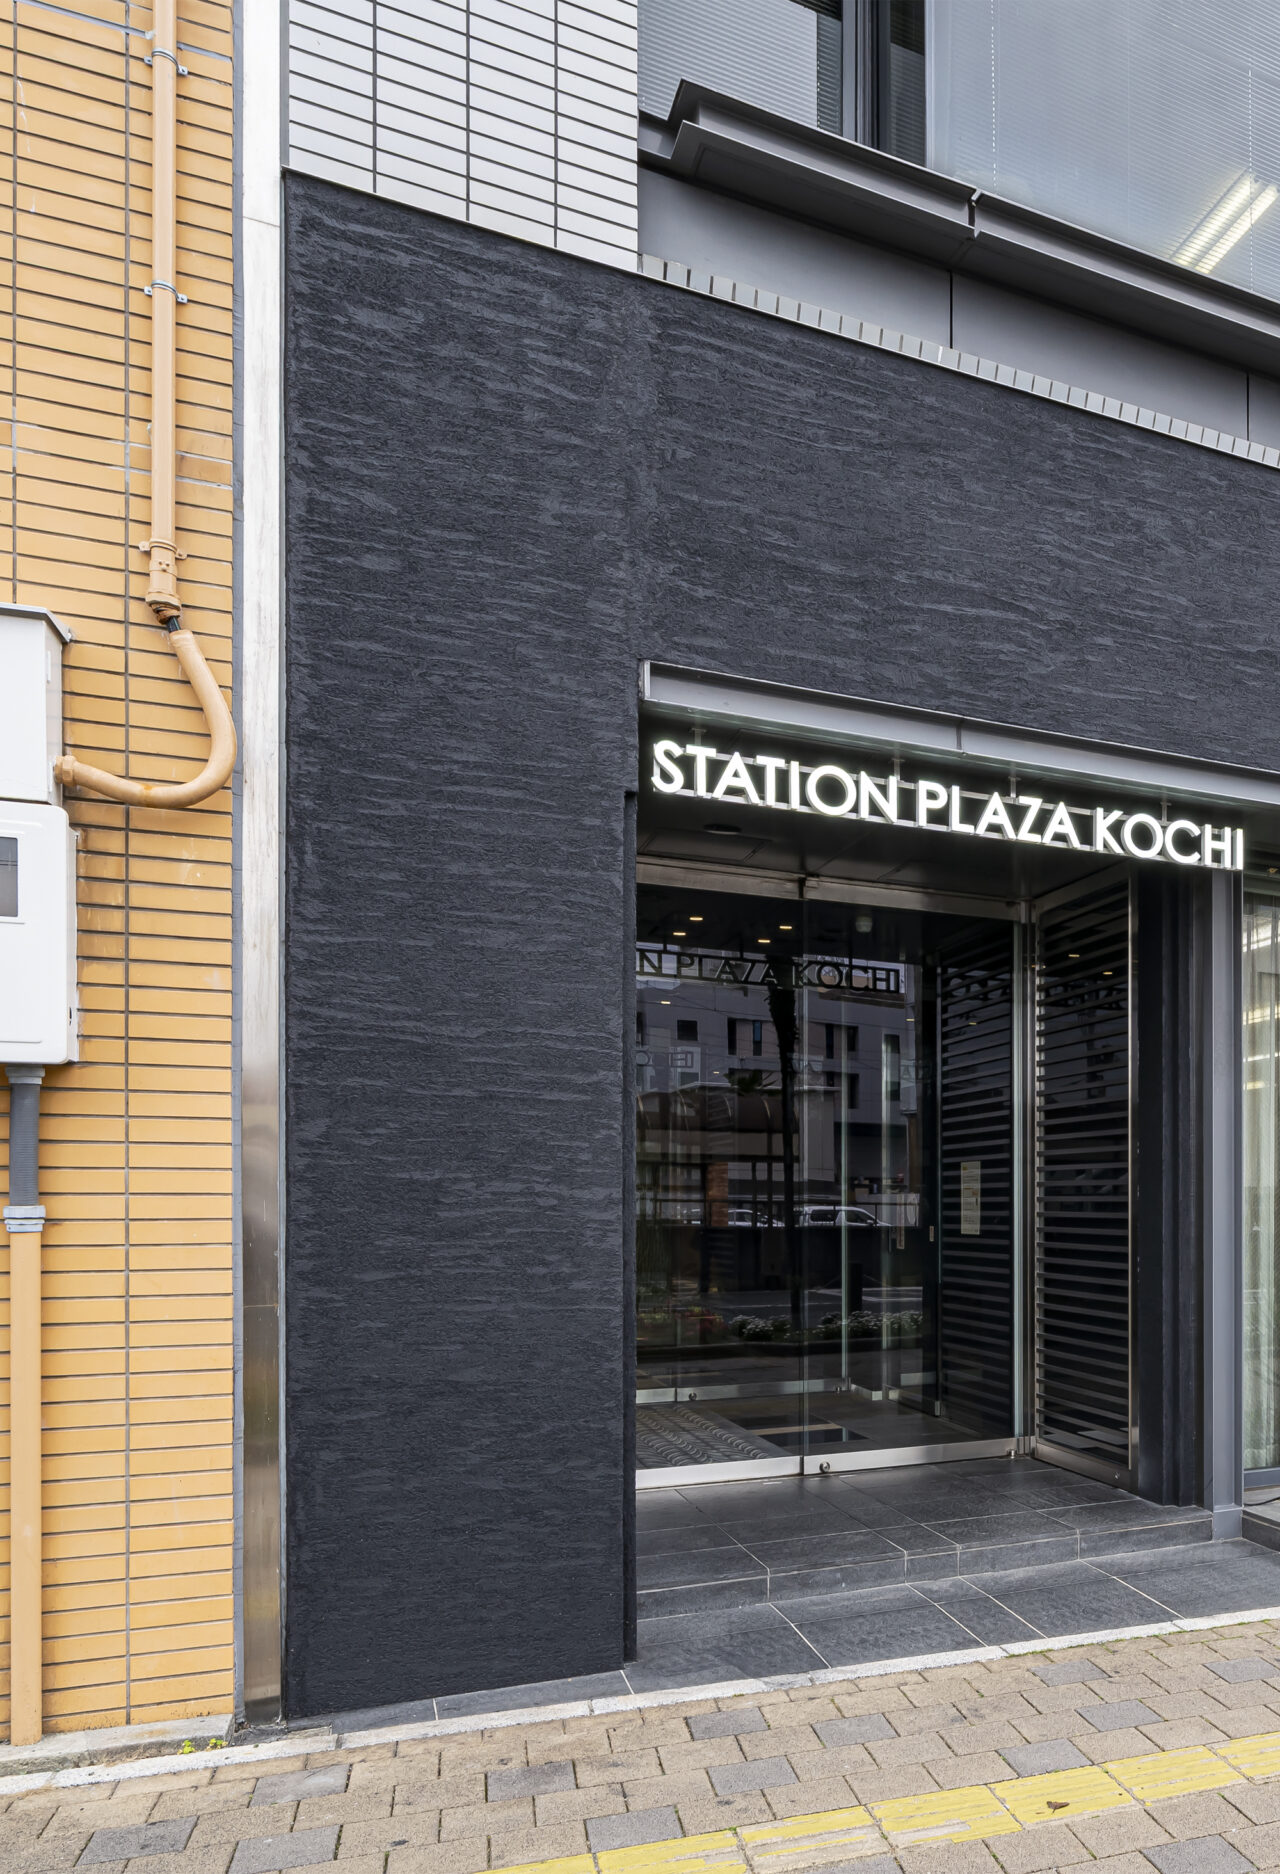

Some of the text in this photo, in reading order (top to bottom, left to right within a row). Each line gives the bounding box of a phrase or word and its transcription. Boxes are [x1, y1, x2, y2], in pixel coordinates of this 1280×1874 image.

[651, 740, 1244, 871] STATION PLAZA KOCHI
[791, 961, 900, 994] KOCHI
